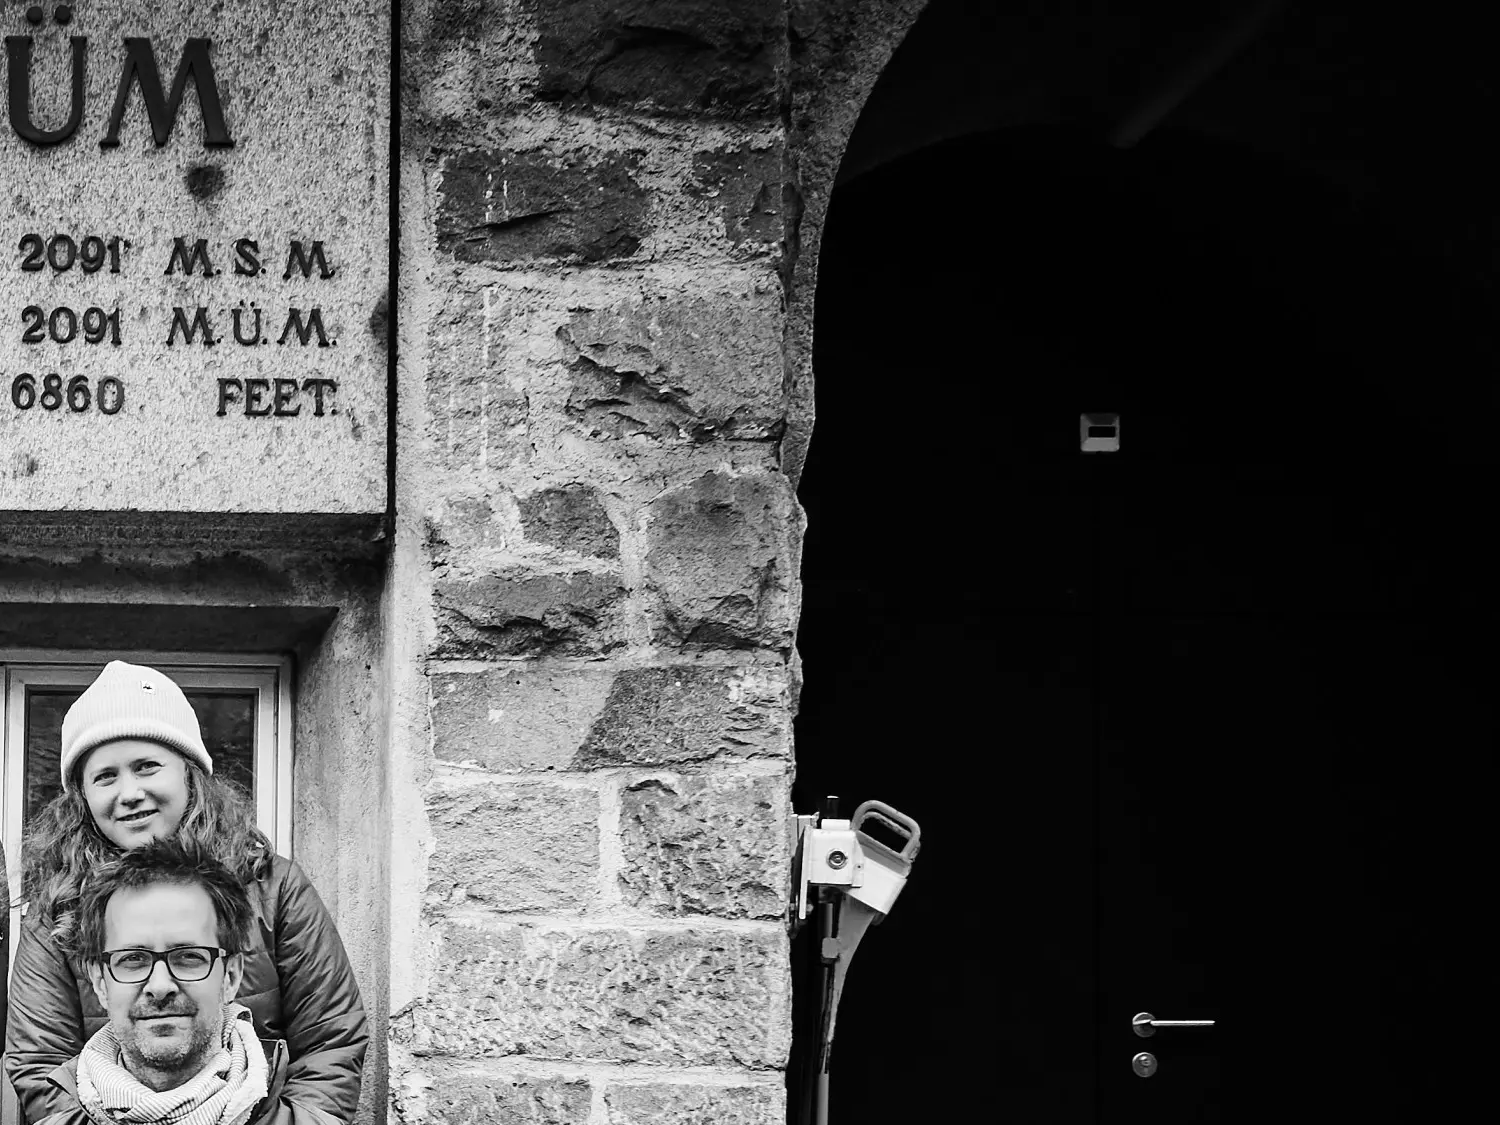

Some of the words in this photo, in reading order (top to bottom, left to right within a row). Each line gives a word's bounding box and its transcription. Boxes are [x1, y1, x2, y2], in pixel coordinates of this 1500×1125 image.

[18, 233, 121, 273] 2091
[21, 305, 122, 346] 2091
[11, 373, 125, 415] 6860
[216, 377, 338, 416] FEET.
